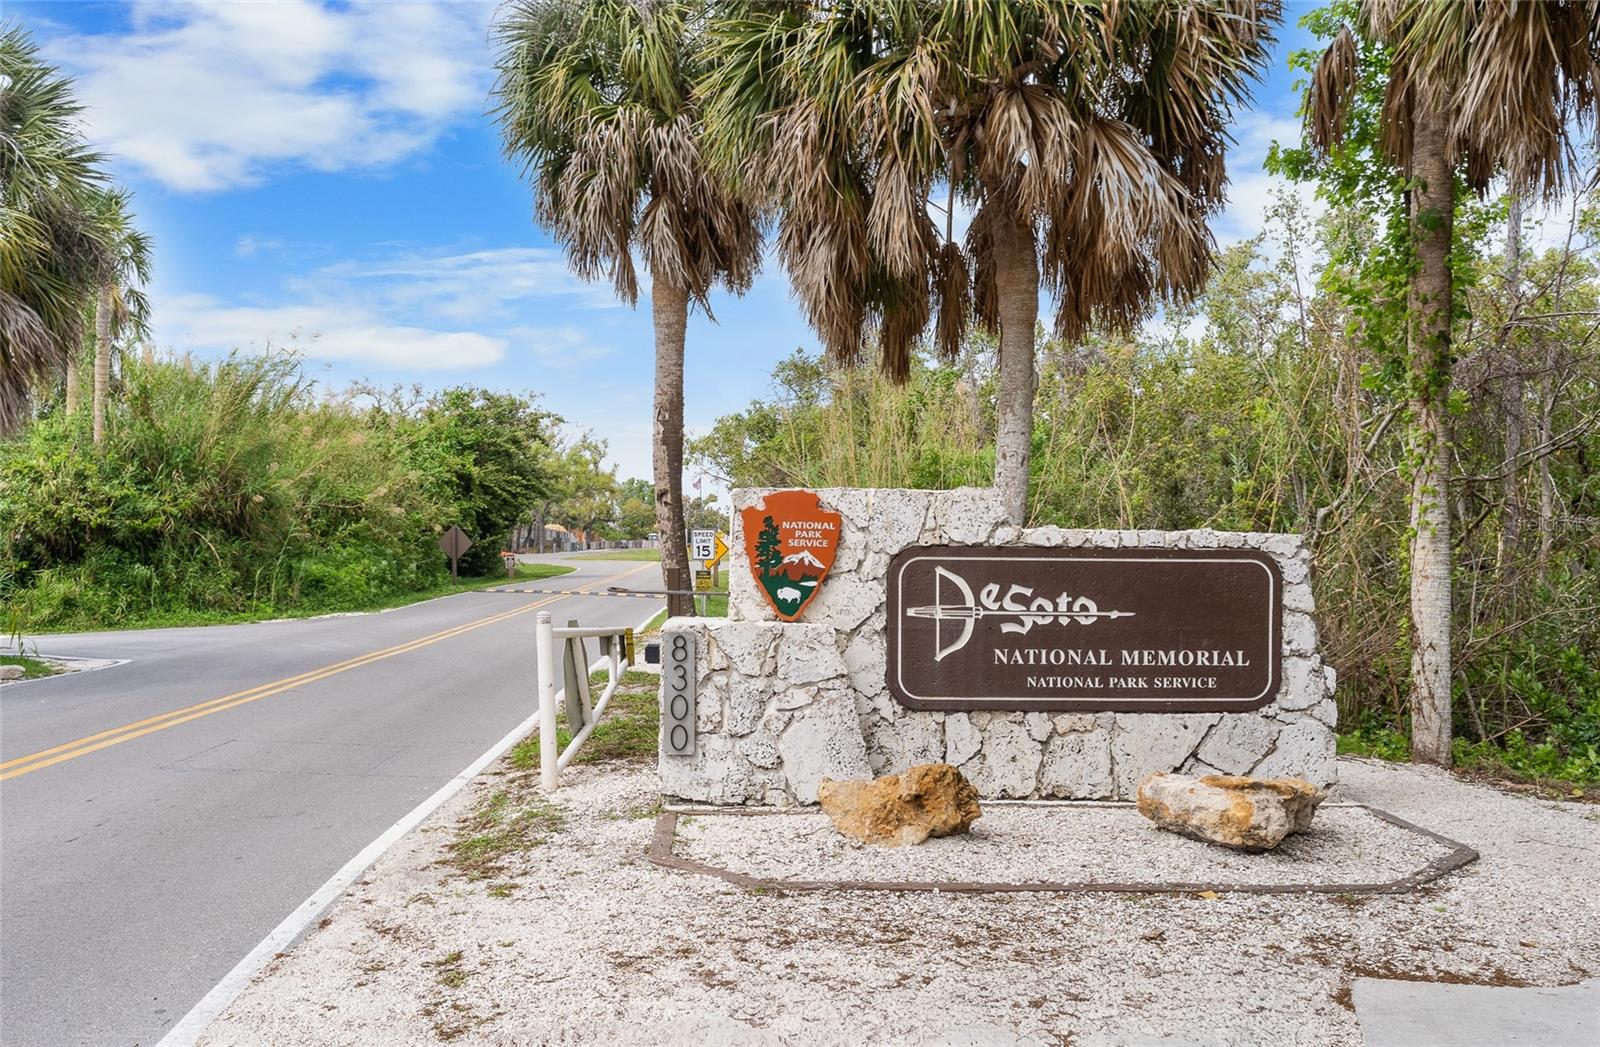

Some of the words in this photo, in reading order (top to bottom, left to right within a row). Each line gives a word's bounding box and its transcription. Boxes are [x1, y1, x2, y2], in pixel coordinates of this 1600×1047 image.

[782, 521, 836, 532] NATIONAL
[794, 530, 822, 539] PARK
[788, 538, 828, 548] SERVICE
[696, 545, 711, 557] 15
[993, 648, 1113, 667] NATIONAL
[1120, 649, 1250, 668] MEMORIAL
[1027, 676, 1104, 690] NATIONAL
[1108, 677, 1149, 689] PARK
[1153, 677, 1218, 689] SERVICE
[669, 634, 689, 752] 8300
